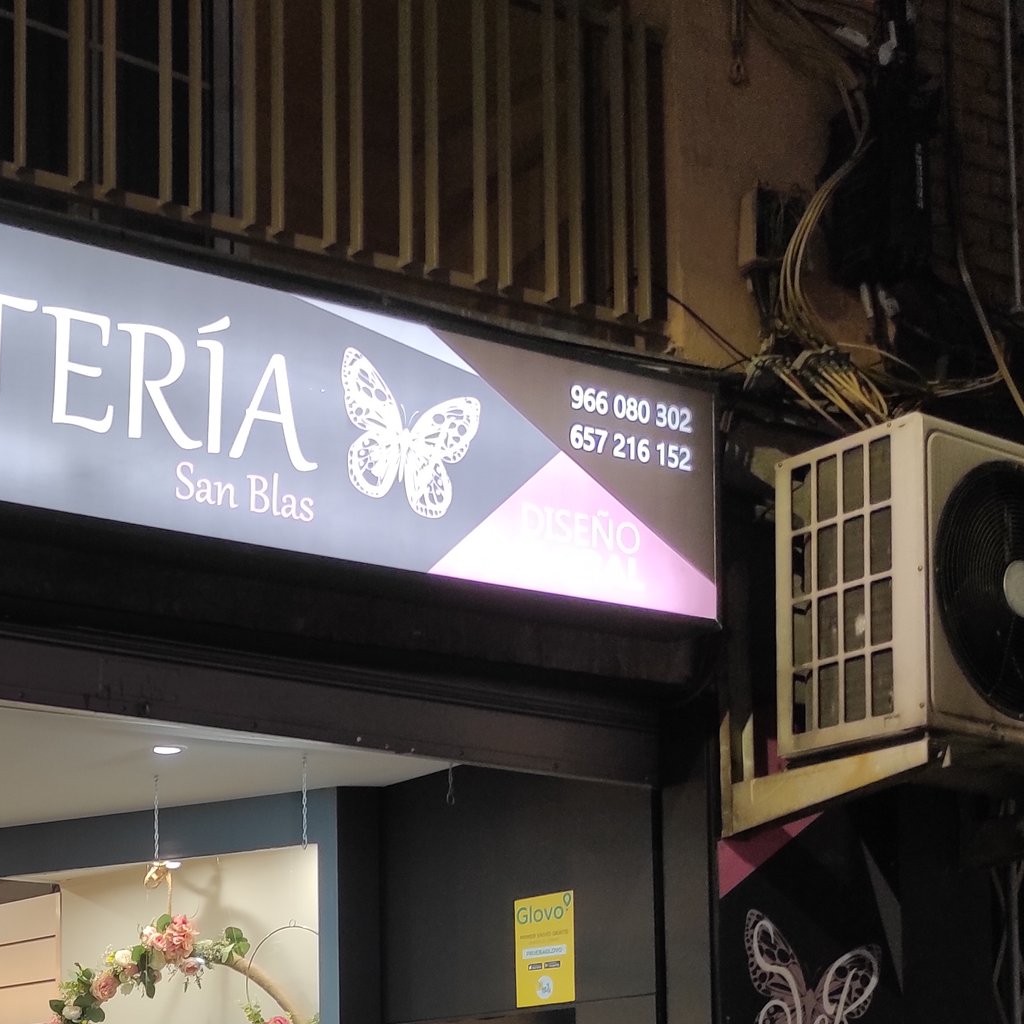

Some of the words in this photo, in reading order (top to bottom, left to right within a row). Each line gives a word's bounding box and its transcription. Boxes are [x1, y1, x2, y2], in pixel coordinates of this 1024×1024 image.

[570, 385, 608, 415] 966
[614, 394, 651, 424] 080
[656, 403, 693, 433] 302
[570, 424, 608, 454] 657
[613, 433, 650, 463] 216
[656, 443, 693, 472] 152
[175, 462, 240, 510] San
[250, 471, 316, 523] Blas
[520, 501, 641, 554] DISEÑO
[517, 907, 564, 925] Glovo
